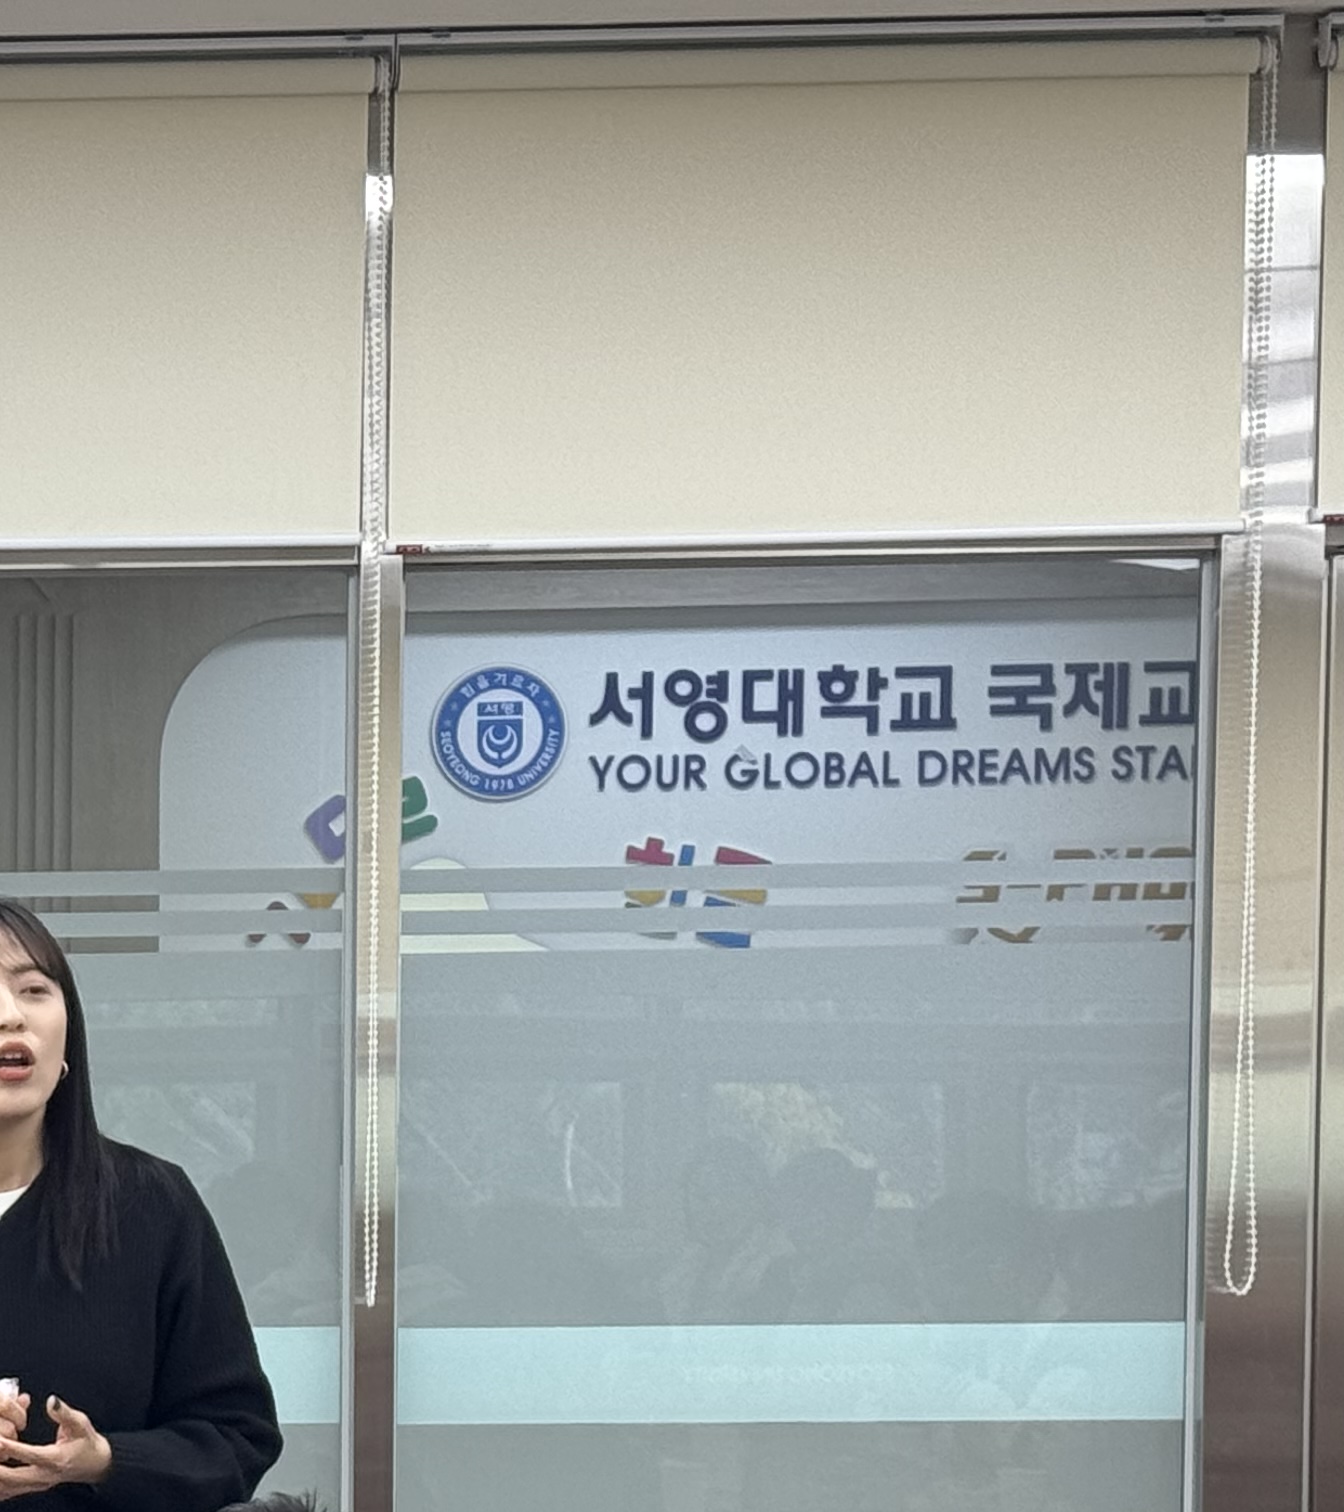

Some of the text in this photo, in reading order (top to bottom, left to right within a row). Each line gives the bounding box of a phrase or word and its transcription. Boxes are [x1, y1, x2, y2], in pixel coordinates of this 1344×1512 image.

[483, 703, 516, 715] 서영
[588, 659, 1196, 744] 서영대학교 국제교
[440, 730, 481, 786] SEOYEONG
[516, 728, 561, 786] UNIVERSITY
[588, 744, 1196, 792] YOUR GLOBAL DREAMS STA
